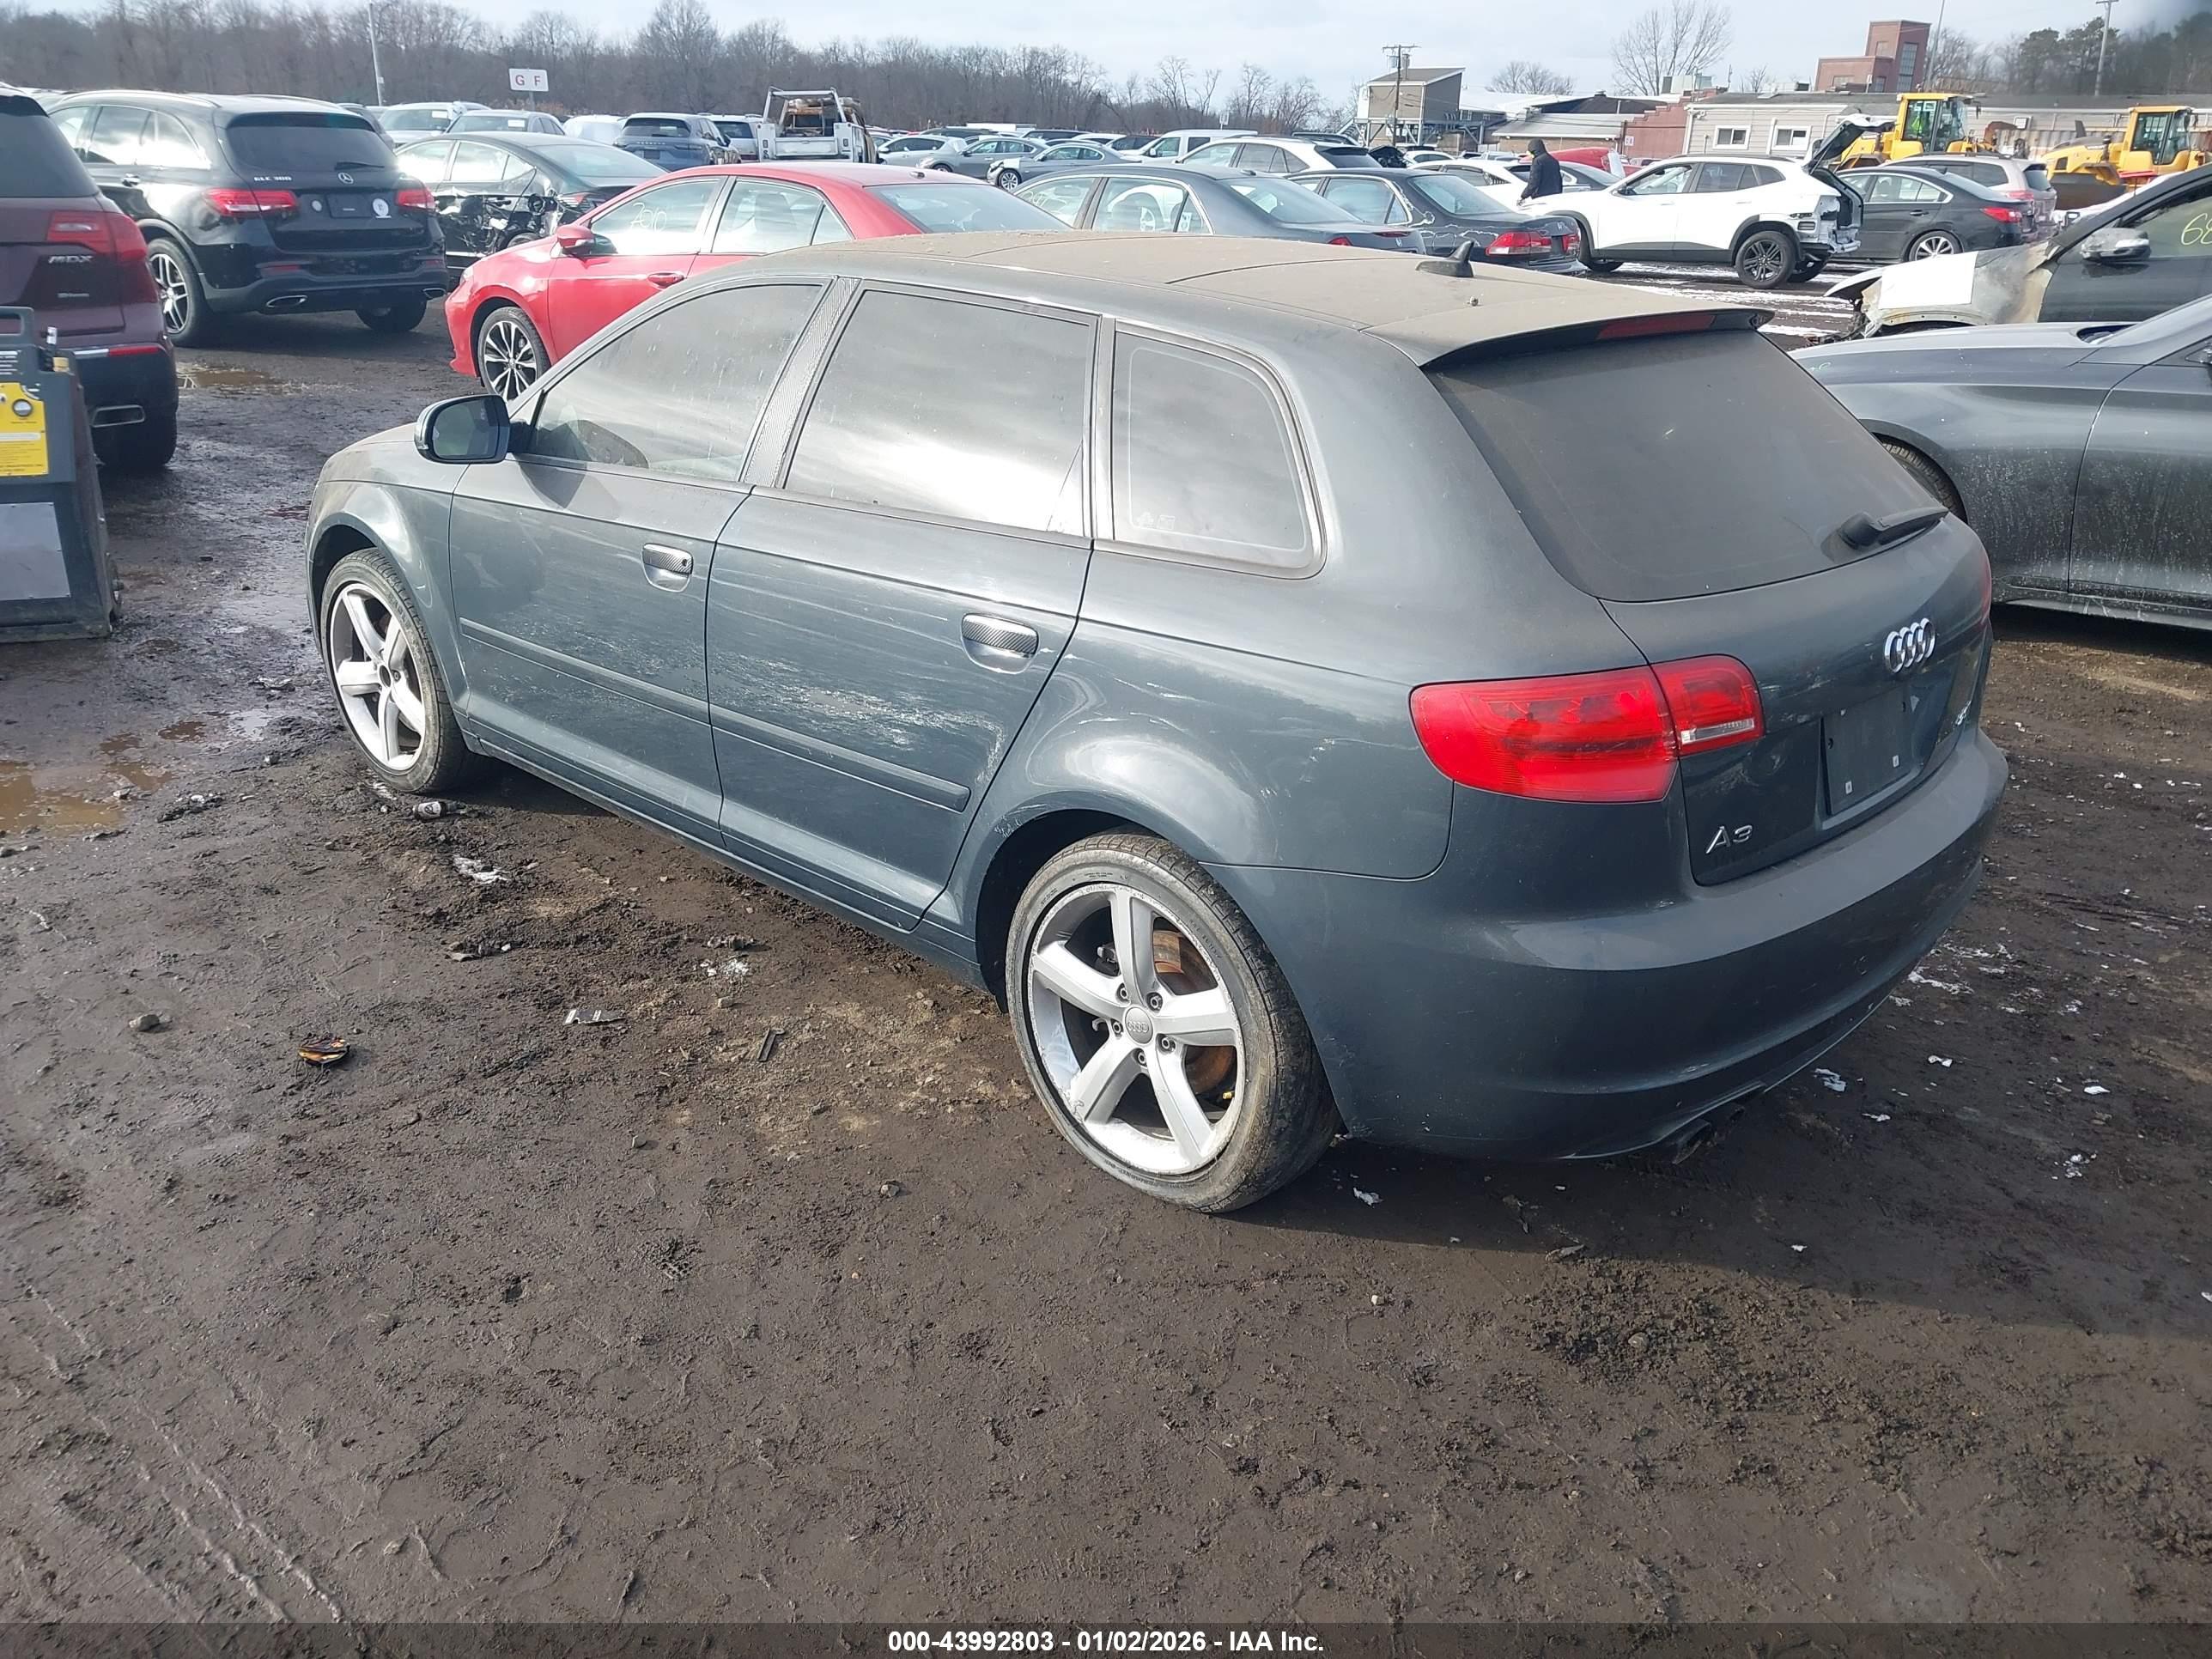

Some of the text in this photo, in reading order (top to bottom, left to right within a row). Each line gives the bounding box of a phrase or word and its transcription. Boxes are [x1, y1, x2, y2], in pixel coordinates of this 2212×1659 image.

[515, 75, 541, 87] G F
[1705, 824, 1753, 854] A3
